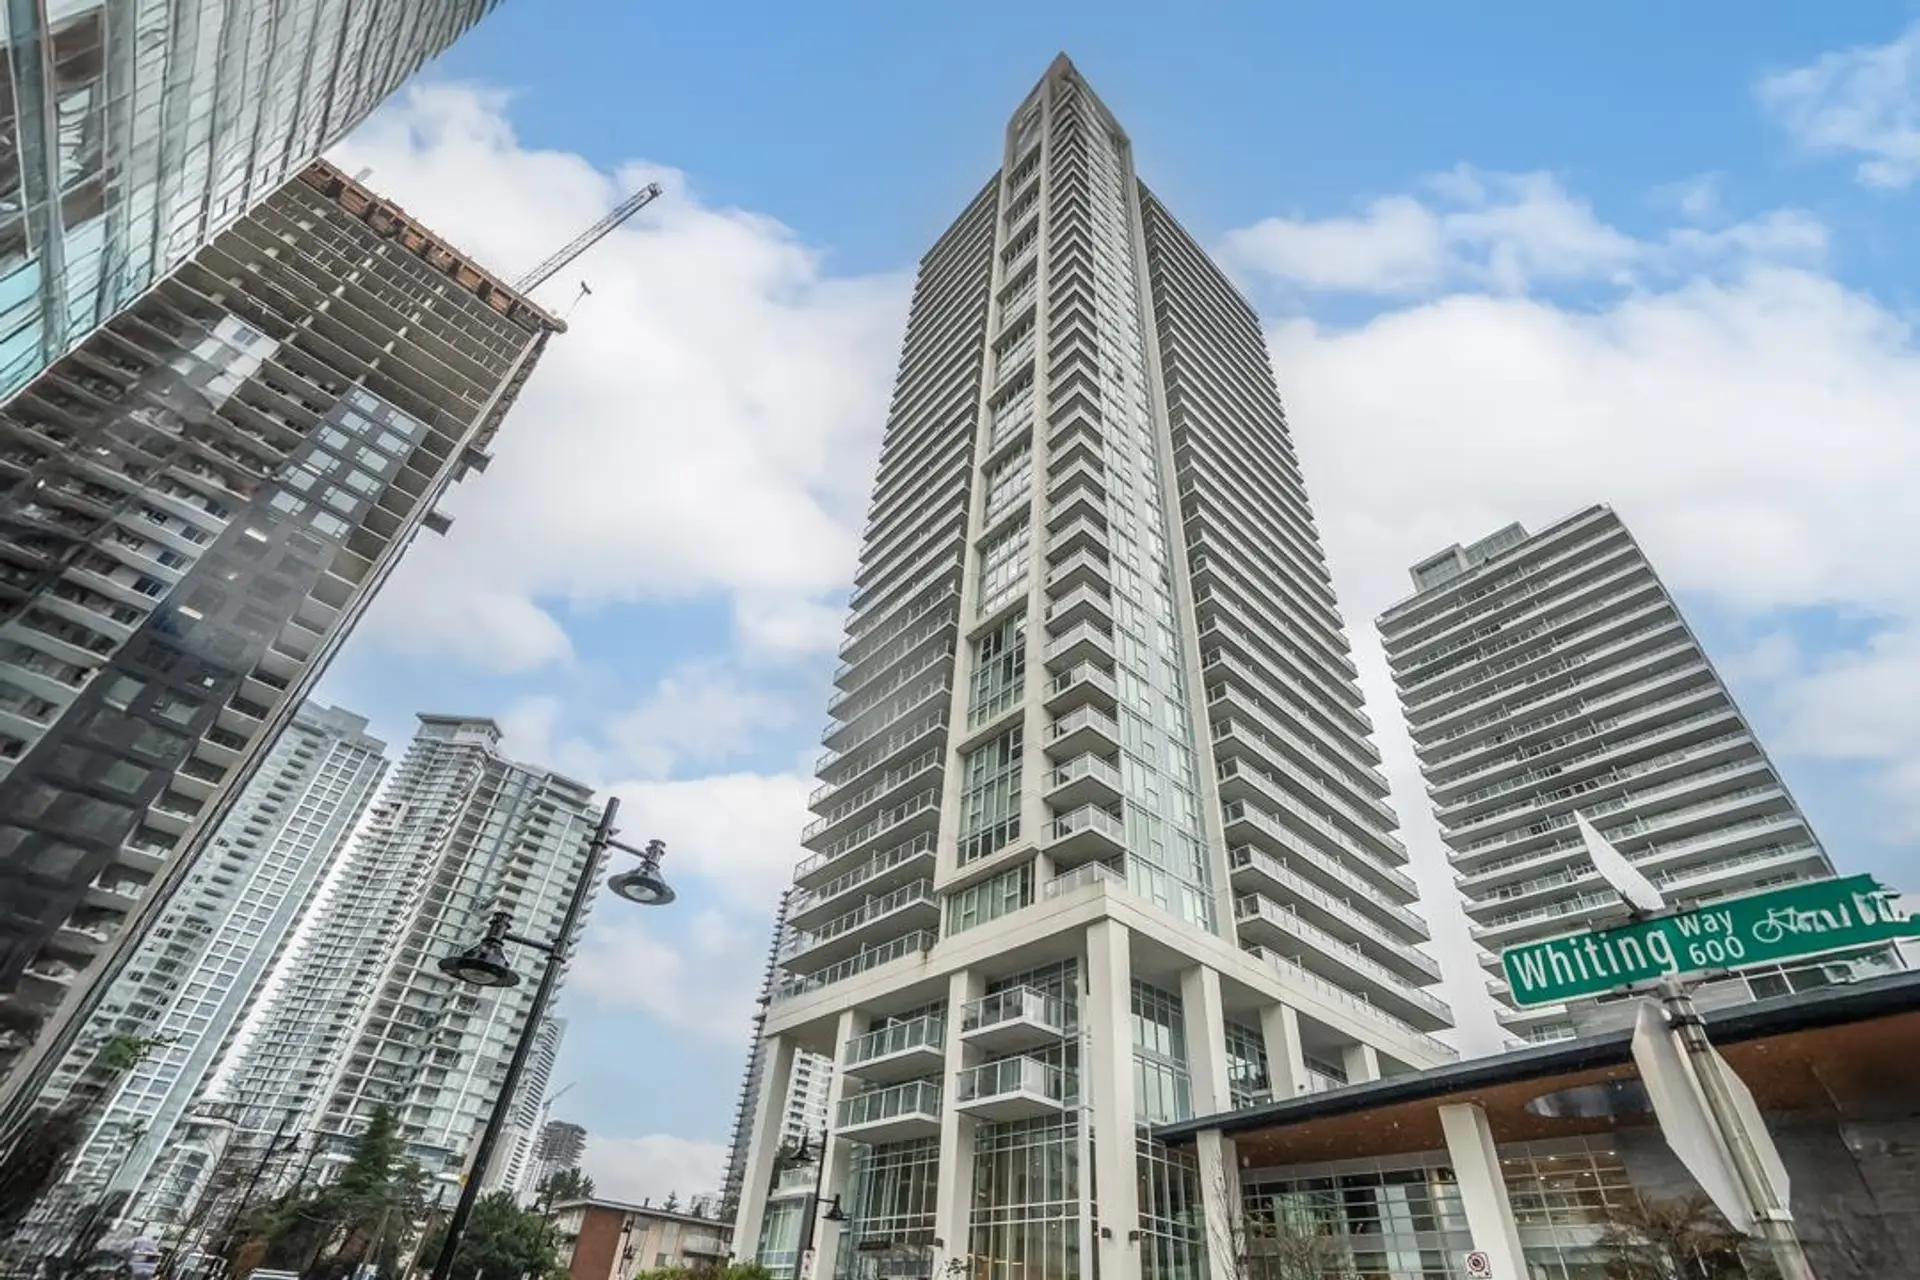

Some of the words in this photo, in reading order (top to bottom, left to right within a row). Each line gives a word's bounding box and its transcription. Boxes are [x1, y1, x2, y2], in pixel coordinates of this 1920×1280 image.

[1512, 930, 1679, 991] Whiting
[1675, 910, 1733, 937] Way
[1689, 936, 1745, 965] 600
